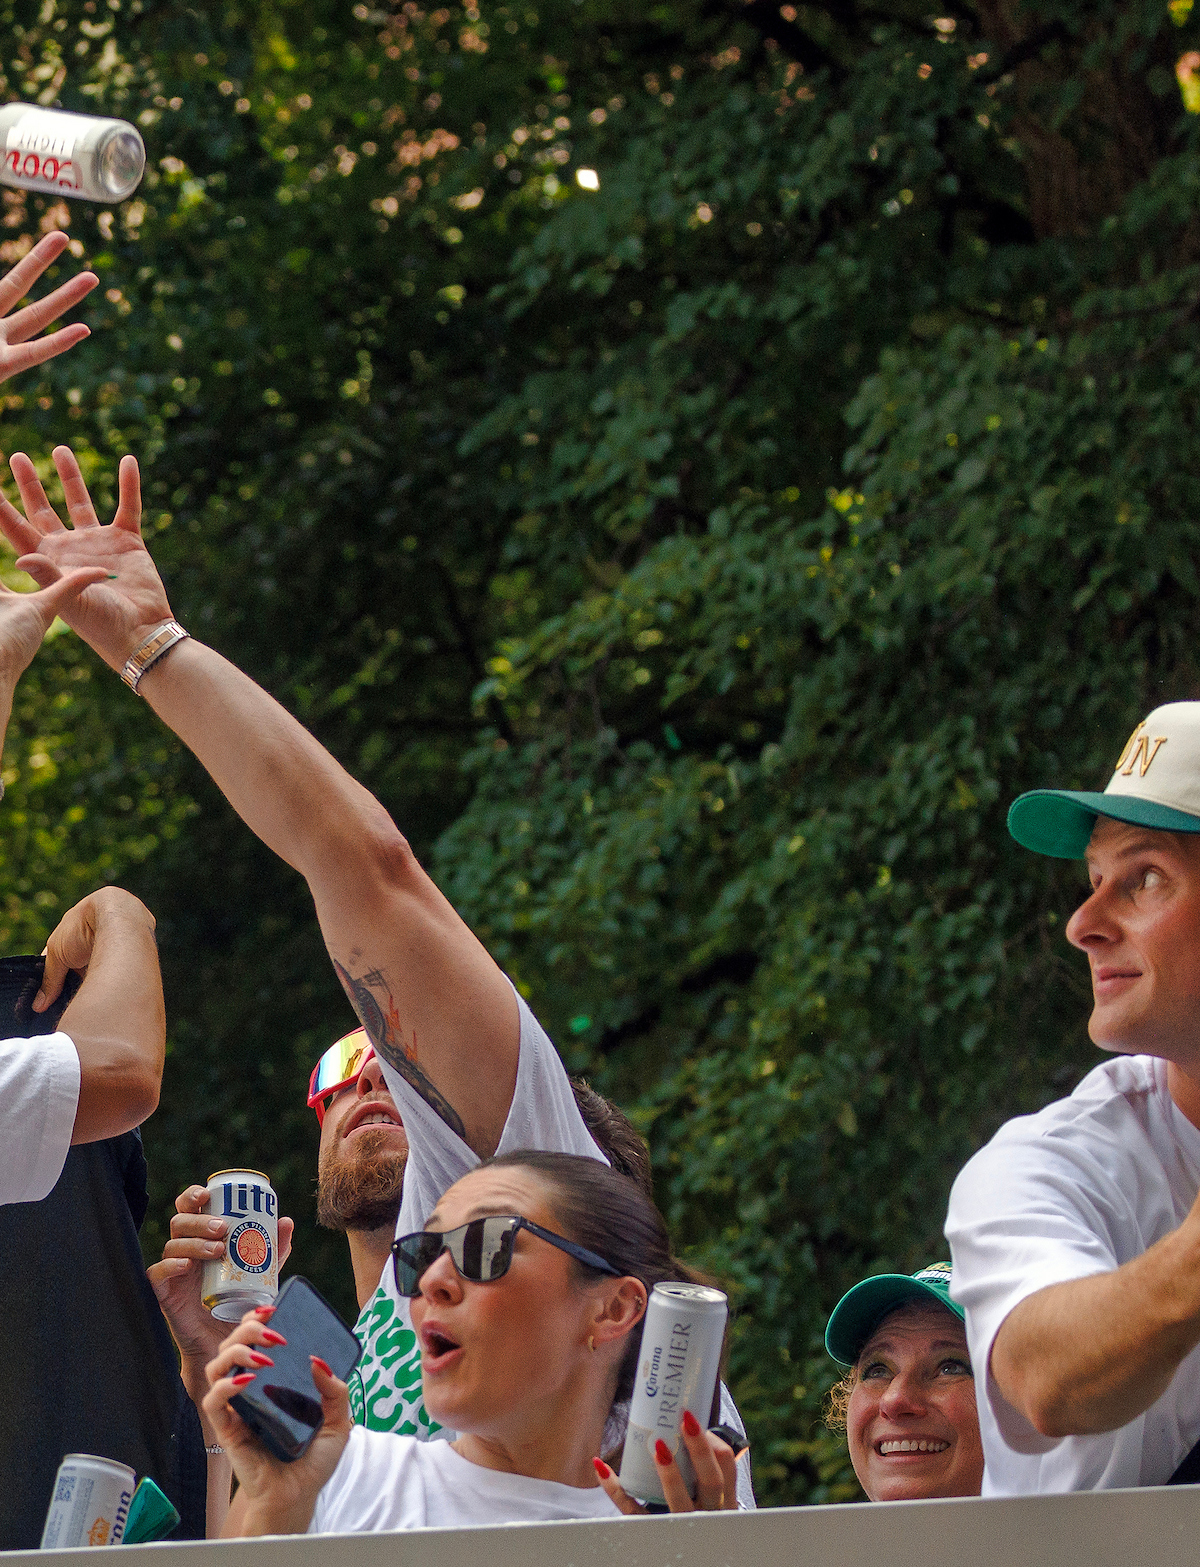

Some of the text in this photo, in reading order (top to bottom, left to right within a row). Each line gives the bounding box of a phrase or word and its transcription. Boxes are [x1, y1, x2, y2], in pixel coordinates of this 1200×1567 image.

[221, 1182, 276, 1219] Lite
[645, 1346, 663, 1398] Corona
[657, 1322, 692, 1429] PREMIER
